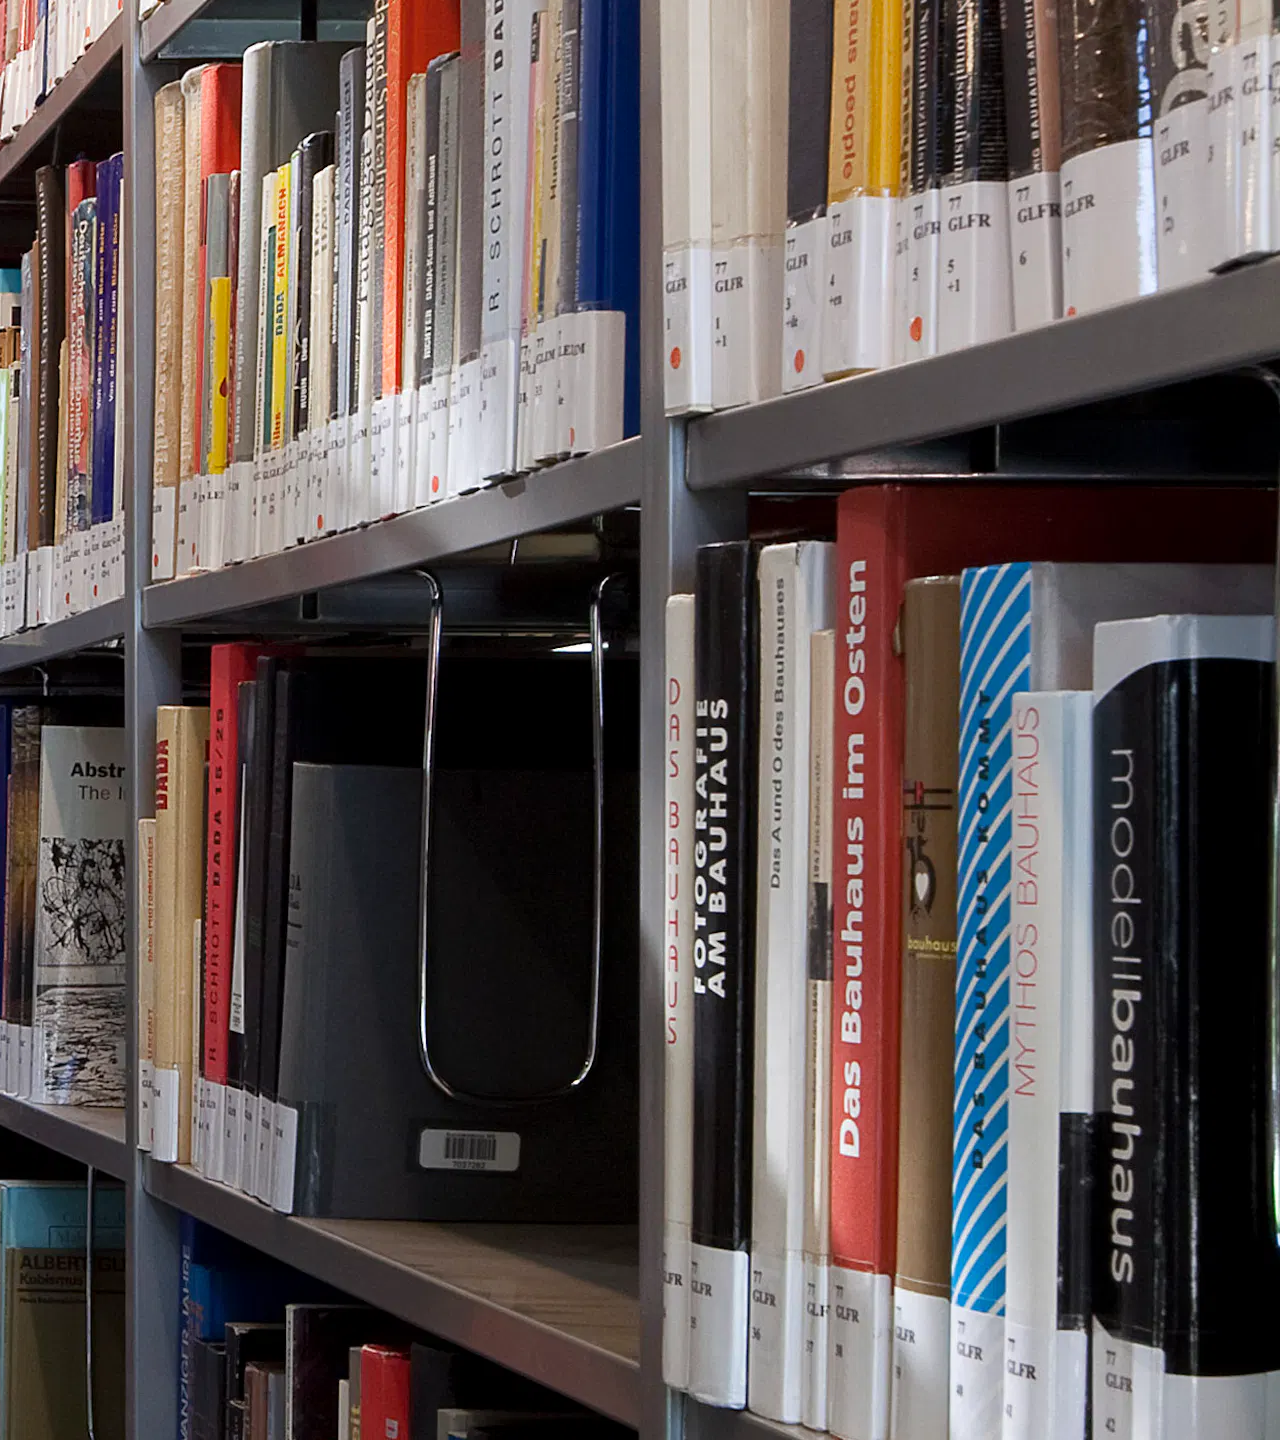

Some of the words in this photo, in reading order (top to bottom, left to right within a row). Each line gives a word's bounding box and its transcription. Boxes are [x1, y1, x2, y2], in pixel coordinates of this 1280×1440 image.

[841, 74, 859, 180] people
[490, 88, 503, 260] SCHROTT
[277, 188, 287, 278] ALMANACH
[948, 213, 991, 233] GLFR
[275, 292, 284, 337] DADA
[489, 275, 502, 313] R.
[774, 577, 784, 703] Bauhauses
[844, 560, 867, 716] Osten
[668, 678, 680, 778] DAS
[773, 710, 783, 750] des
[71, 761, 127, 778] Abstr
[78, 785, 110, 800] The
[156, 740, 168, 810] DADA
[773, 756, 782, 771] O
[843, 733, 865, 799] im
[977, 689, 990, 844] KOMMT
[708, 699, 728, 913] BAUHAUS
[771, 786, 782, 820] und
[771, 827, 780, 844] A
[1012, 707, 1039, 906] BAUHAUS
[694, 700, 708, 995] FOTOGRAFIE
[770, 849, 780, 889] Das
[667, 801, 679, 1045] BAUHAUS
[841, 817, 864, 1044] Bauhaus
[908, 934, 957, 952] bauhaus
[708, 932, 727, 998] AM
[974, 870, 988, 1070] BAUHAUS
[1014, 923, 1039, 1097] MYTHOS
[1109, 748, 1141, 1283] modellbauhaus
[841, 1061, 862, 1158] Das
[971, 1092, 986, 1170] DAS
[20, 1256, 86, 1270] ALBERT
[20, 1273, 84, 1285] Kubismus
[182, 1244, 191, 1321] JAHRE
[752, 1289, 776, 1308] GLFR
[957, 1341, 983, 1361] GLFR
[1105, 1372, 1132, 1392] GLFR
